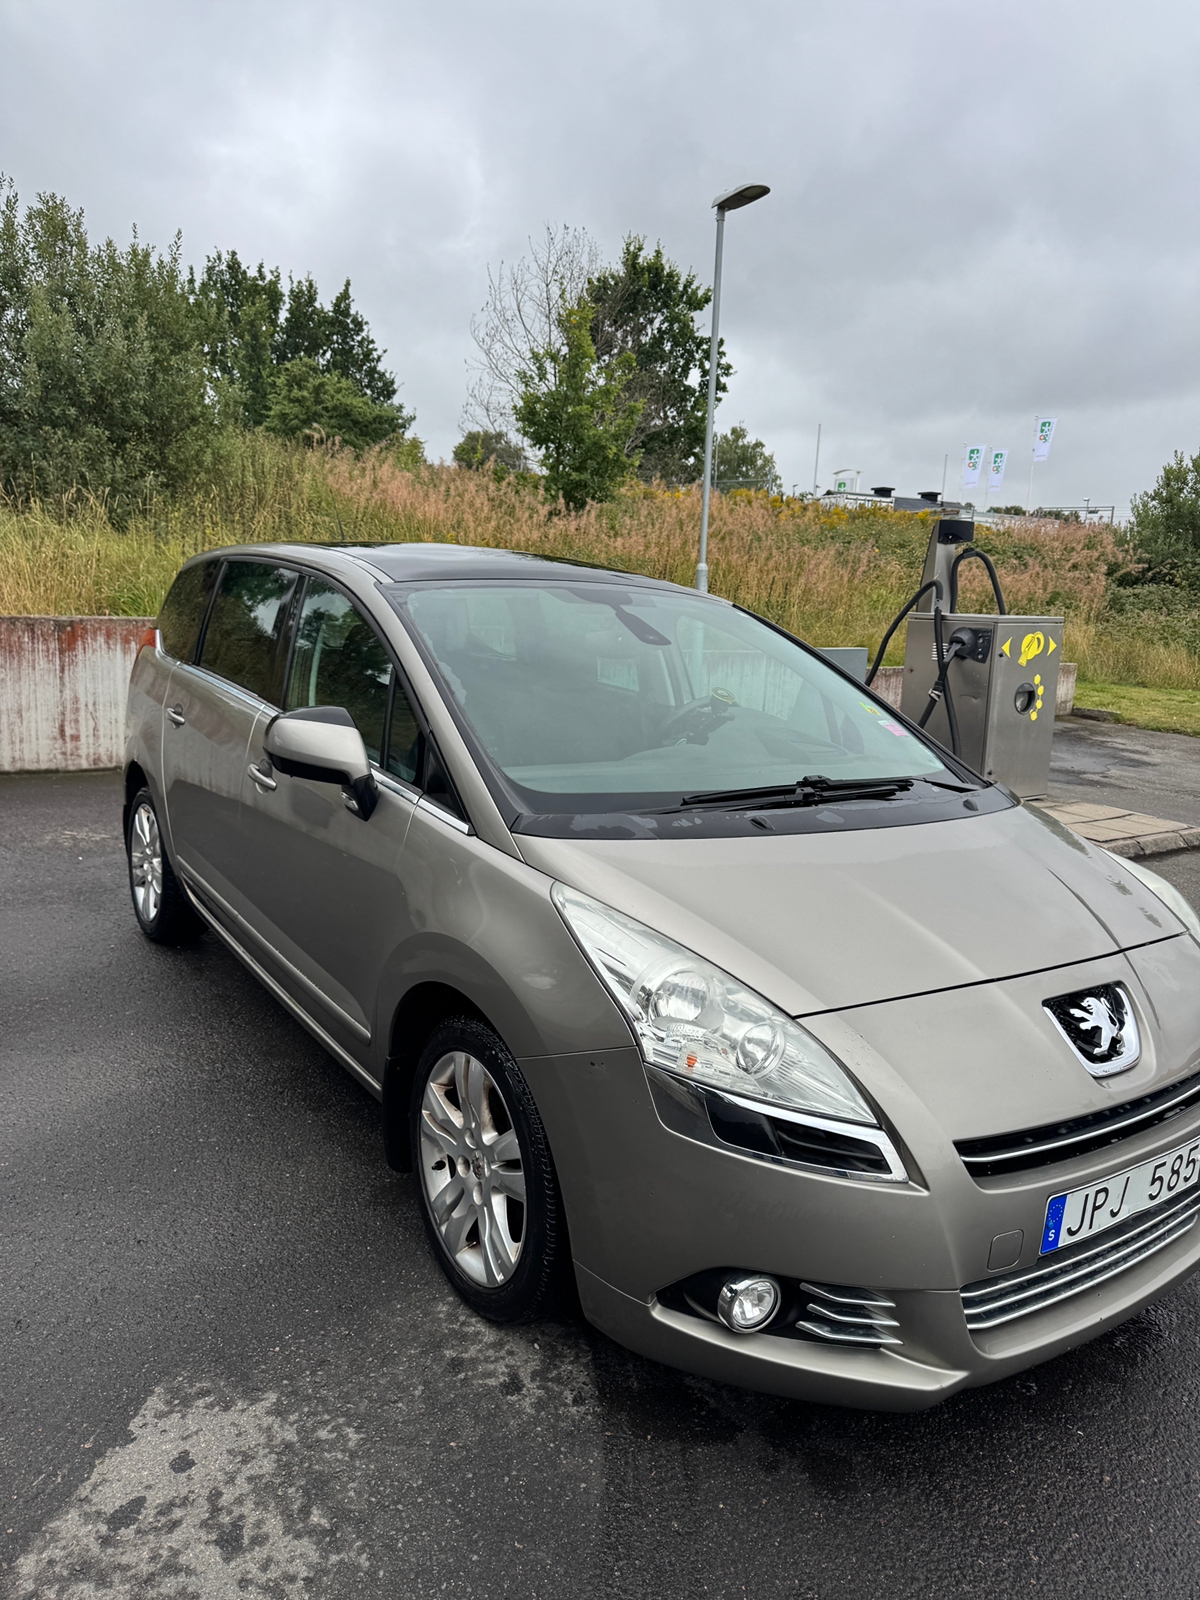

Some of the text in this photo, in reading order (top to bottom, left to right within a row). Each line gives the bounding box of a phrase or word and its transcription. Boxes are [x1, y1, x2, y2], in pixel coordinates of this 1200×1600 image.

[1066, 1144, 1199, 1237] JPJ 585
[1048, 1229, 1055, 1241] S
